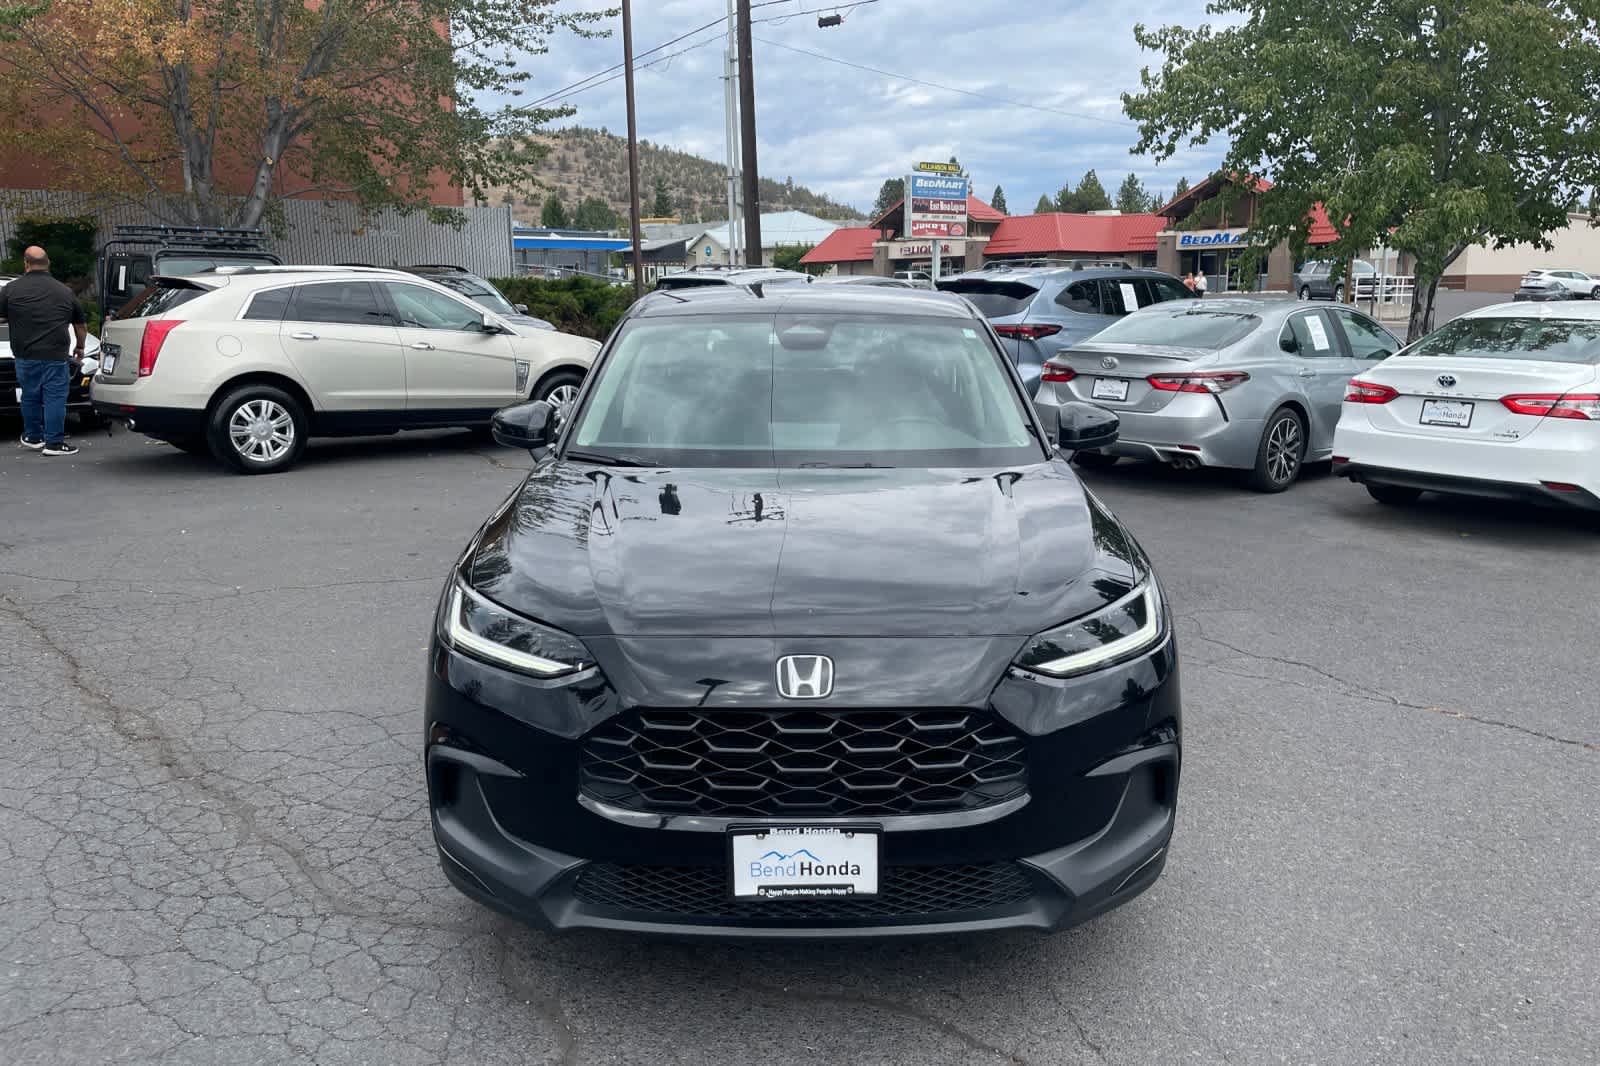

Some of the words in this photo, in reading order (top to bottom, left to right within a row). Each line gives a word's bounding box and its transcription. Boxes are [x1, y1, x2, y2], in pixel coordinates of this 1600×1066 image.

[1181, 231, 1262, 245] BEDMA
[911, 244, 950, 255] LIQR
[750, 862, 796, 877] Bend
[800, 861, 861, 876] Honda
[783, 888, 799, 896] People
[799, 888, 816, 896] Making
[816, 888, 832, 896] People
[832, 888, 847, 896] Happy
